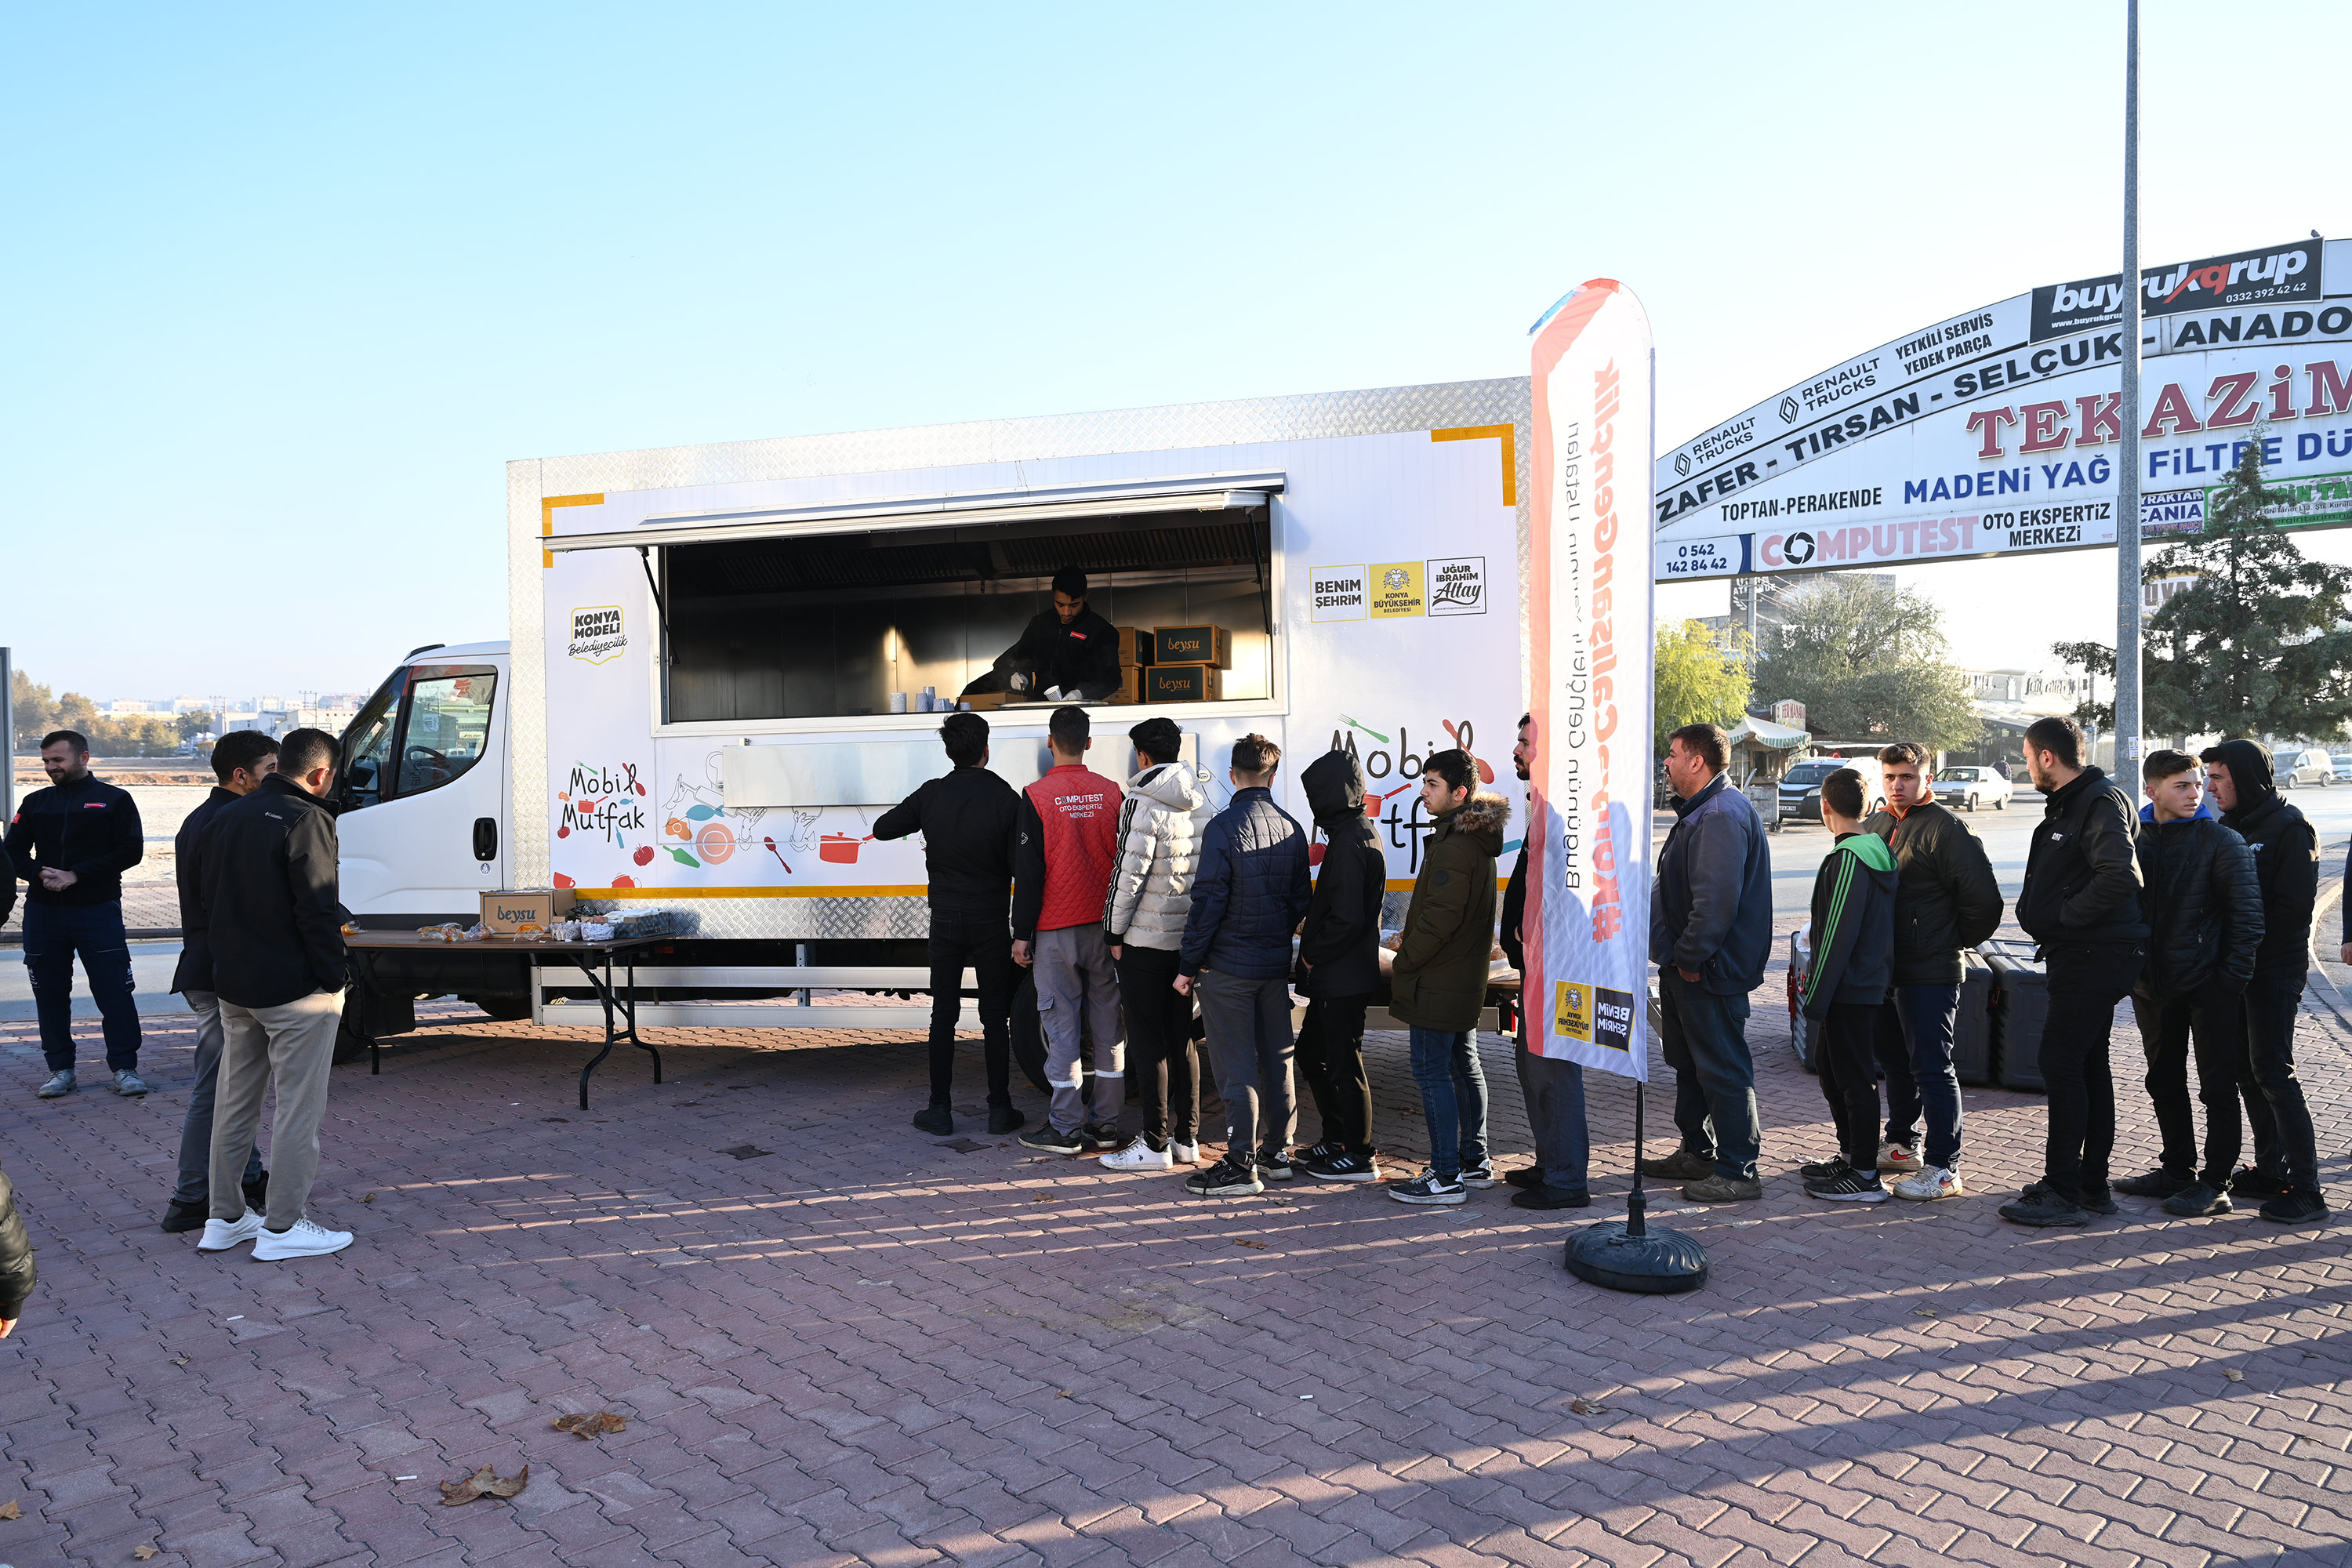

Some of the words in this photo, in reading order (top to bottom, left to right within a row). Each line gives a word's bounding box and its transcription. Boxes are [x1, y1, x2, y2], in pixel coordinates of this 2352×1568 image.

[2226, 291, 2252, 303] 0332
[2255, 287, 2274, 299] 392
[2277, 284, 2291, 296] 42
[2292, 281, 2307, 293] 42
[1944, 313, 1994, 339] SERVİS
[1904, 351, 1944, 376] YEDEK
[1947, 333, 1993, 361] PARÇA
[1801, 357, 1881, 401] RENAULT
[1805, 375, 1877, 412] TRUCKS
[1655, 461, 1761, 524] ZAFER
[1784, 391, 1921, 463] TIRSAN
[1954, 332, 2122, 398] SELÇUK
[2173, 306, 2352, 349] ANADO
[1692, 416, 1756, 456] RENAULT
[1695, 431, 1755, 465] TRUCKS
[2042, 454, 2111, 491] YAĞ
[2298, 428, 2352, 461] DÜ
[1721, 487, 1882, 522] TOPTAN-PERAKENDE
[2141, 503, 2203, 523] CANIA
[1983, 510, 2014, 530] OTO
[1679, 545, 1687, 557] 0
[1690, 543, 1715, 557] 542
[1760, 515, 1980, 567] COMPUTEST
[1442, 564, 1472, 574] UĞUR
[1666, 561, 1689, 573] 142
[1690, 559, 1708, 572] 84
[1710, 557, 1727, 570] 42
[1374, 597, 1421, 608] BÜYÜKŞEHİR
[1432, 582, 1482, 607] Altay
[575, 610, 620, 627] KONYA
[568, 634, 628, 657] Belediyecilik
[1167, 637, 1200, 652] beysu
[1159, 677, 1192, 691] beysu
[569, 764, 637, 797] Mobil
[1054, 793, 1104, 805] COMPUTEST
[562, 802, 644, 843] Mutfak
[497, 906, 536, 923] beysu
